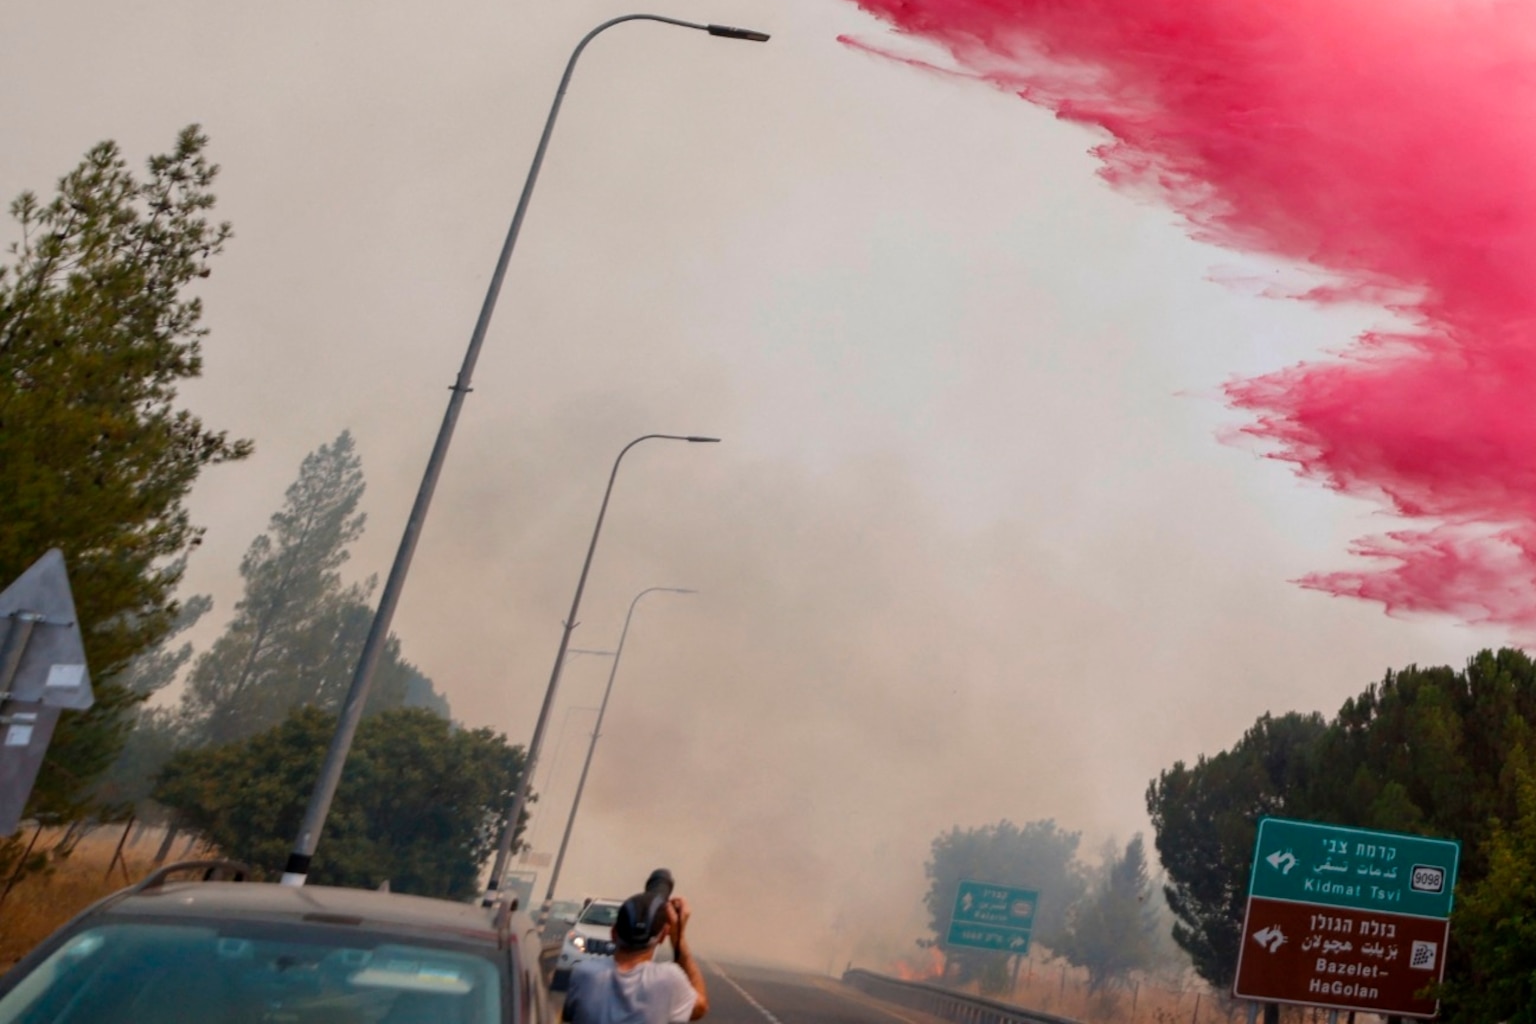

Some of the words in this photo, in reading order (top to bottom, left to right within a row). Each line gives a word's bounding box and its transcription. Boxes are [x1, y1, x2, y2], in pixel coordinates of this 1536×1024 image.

[1322, 839, 1348, 854] צבי
[1356, 843, 1397, 861] קדמת
[1414, 872, 1441, 886] 9098
[1304, 878, 1361, 897] Kidmat
[1371, 885, 1401, 902] Tsvi
[1310, 913, 1353, 932] הגולן
[1359, 919, 1397, 938] בזלת
[1309, 978, 1379, 999] HaGolan
